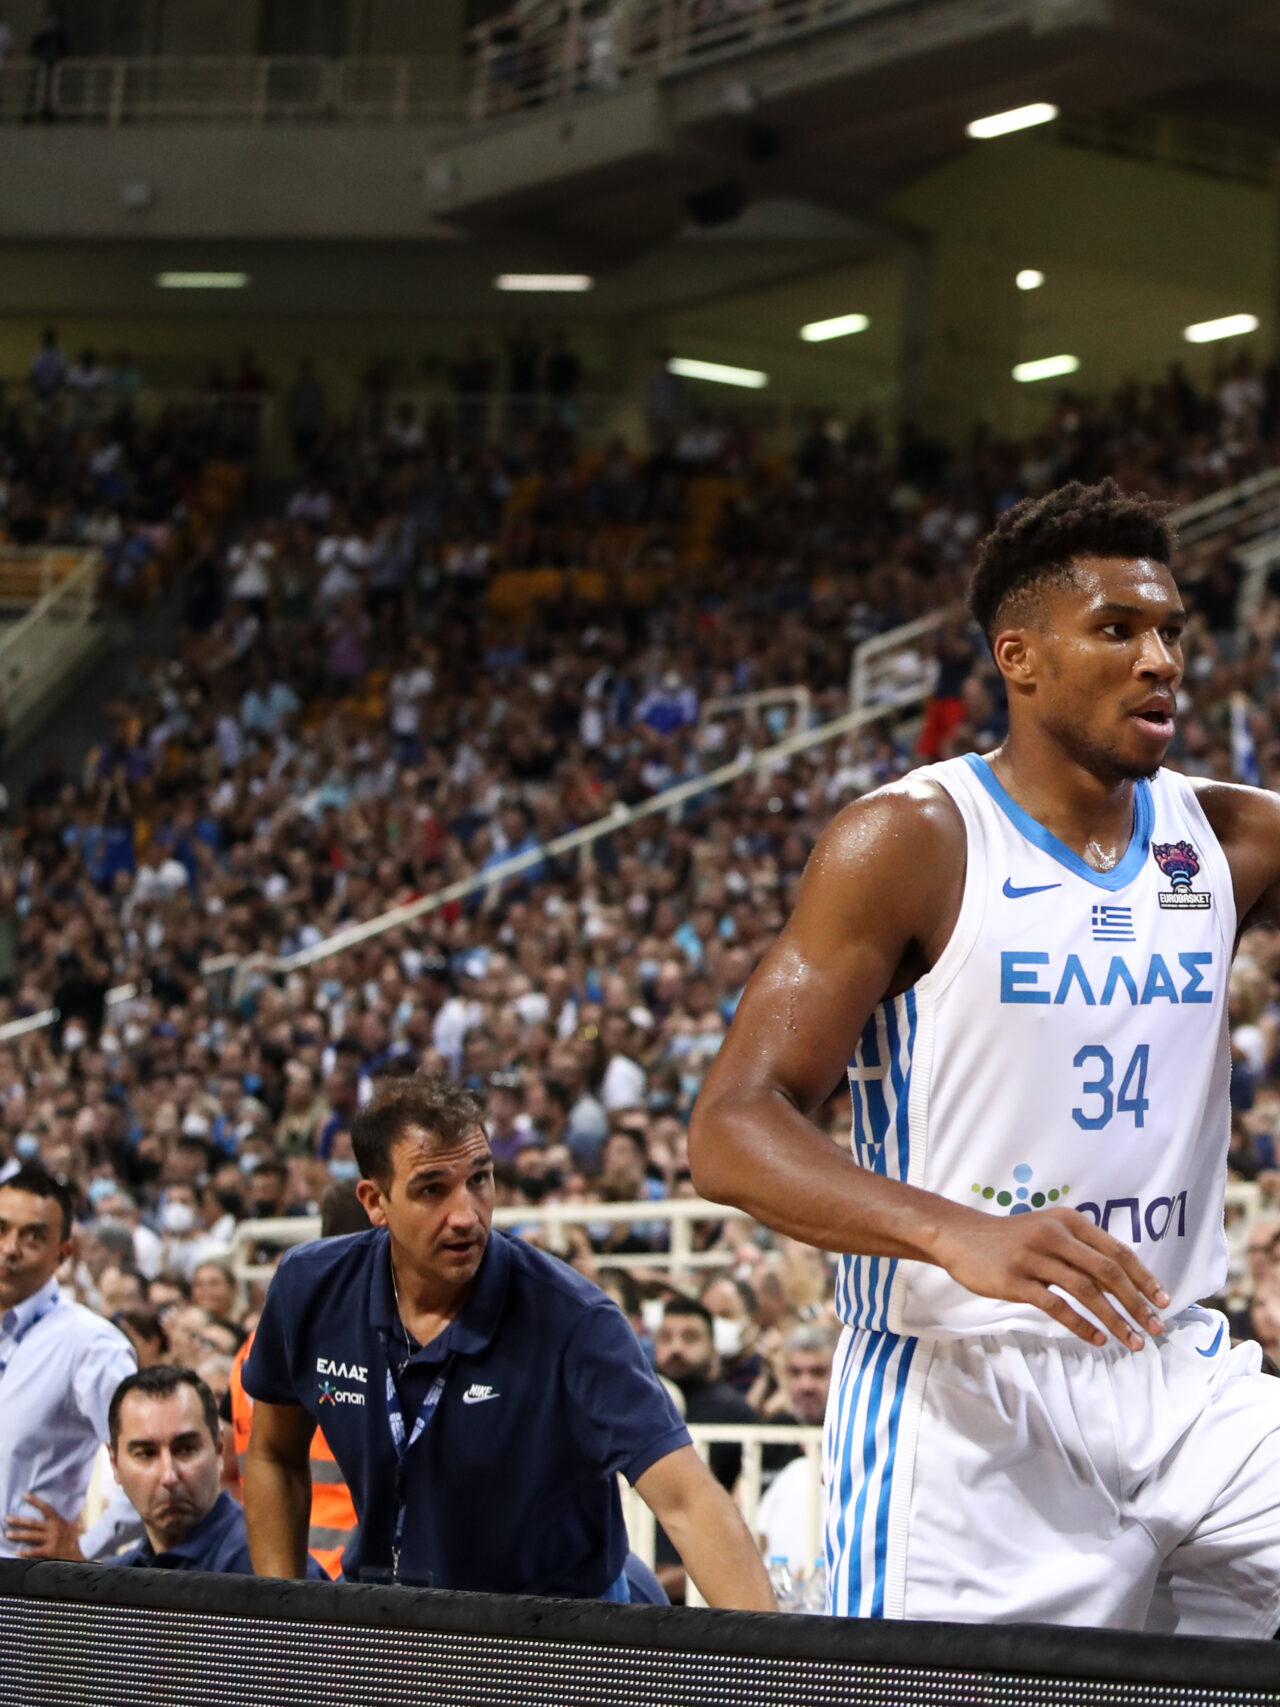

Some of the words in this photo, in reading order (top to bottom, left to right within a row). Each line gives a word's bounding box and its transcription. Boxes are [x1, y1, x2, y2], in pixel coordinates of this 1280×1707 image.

[1160, 893, 1210, 903] EUROBASKET
[1000, 951, 1214, 1006] ΕΛΛΑΣ
[1072, 1044, 1150, 1130] 34
[316, 1357, 368, 1383] ΕΛΛΑΣ
[469, 1383, 493, 1397] NIKE
